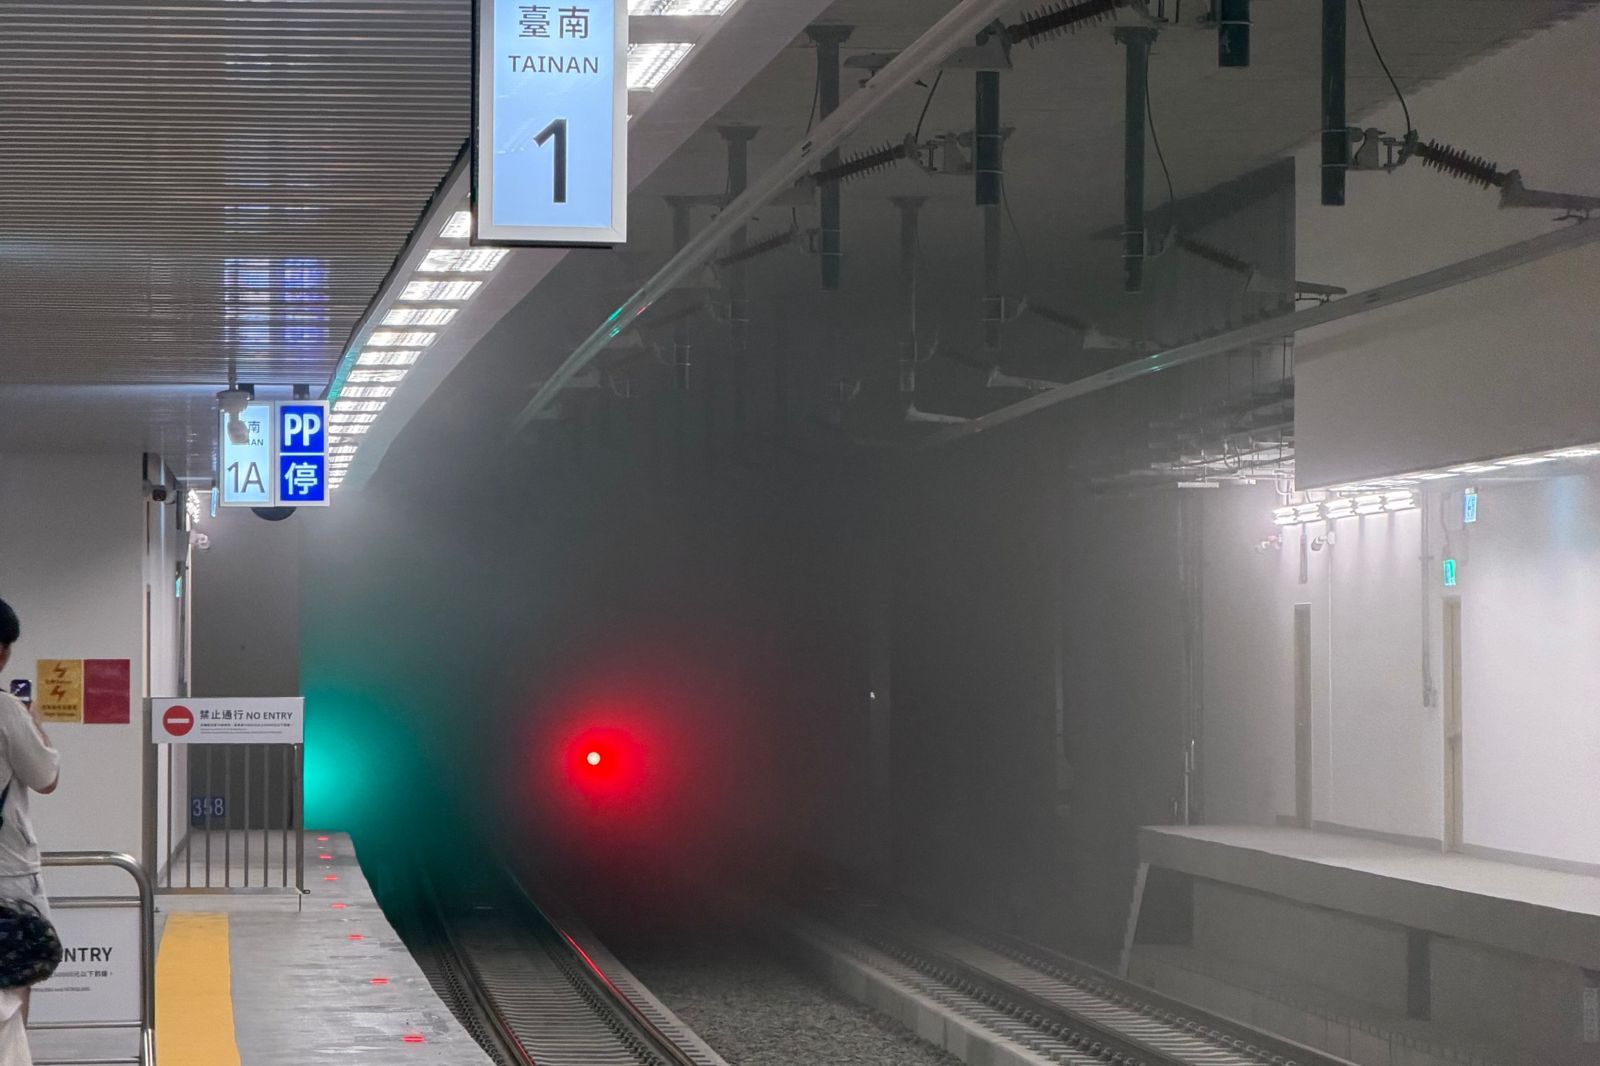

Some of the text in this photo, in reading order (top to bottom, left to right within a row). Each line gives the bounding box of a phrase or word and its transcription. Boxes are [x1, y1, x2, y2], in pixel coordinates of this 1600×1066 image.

[518, 5, 590, 39] 臺南
[508, 55, 599, 74] TAINAN
[533, 118, 567, 203] 1
[284, 413, 321, 447] PP
[227, 461, 265, 493] 1A
[284, 461, 318, 495] 停
[200, 709, 293, 720] 禁止通行 NO ENTRY
[63, 946, 113, 962] NTRY
